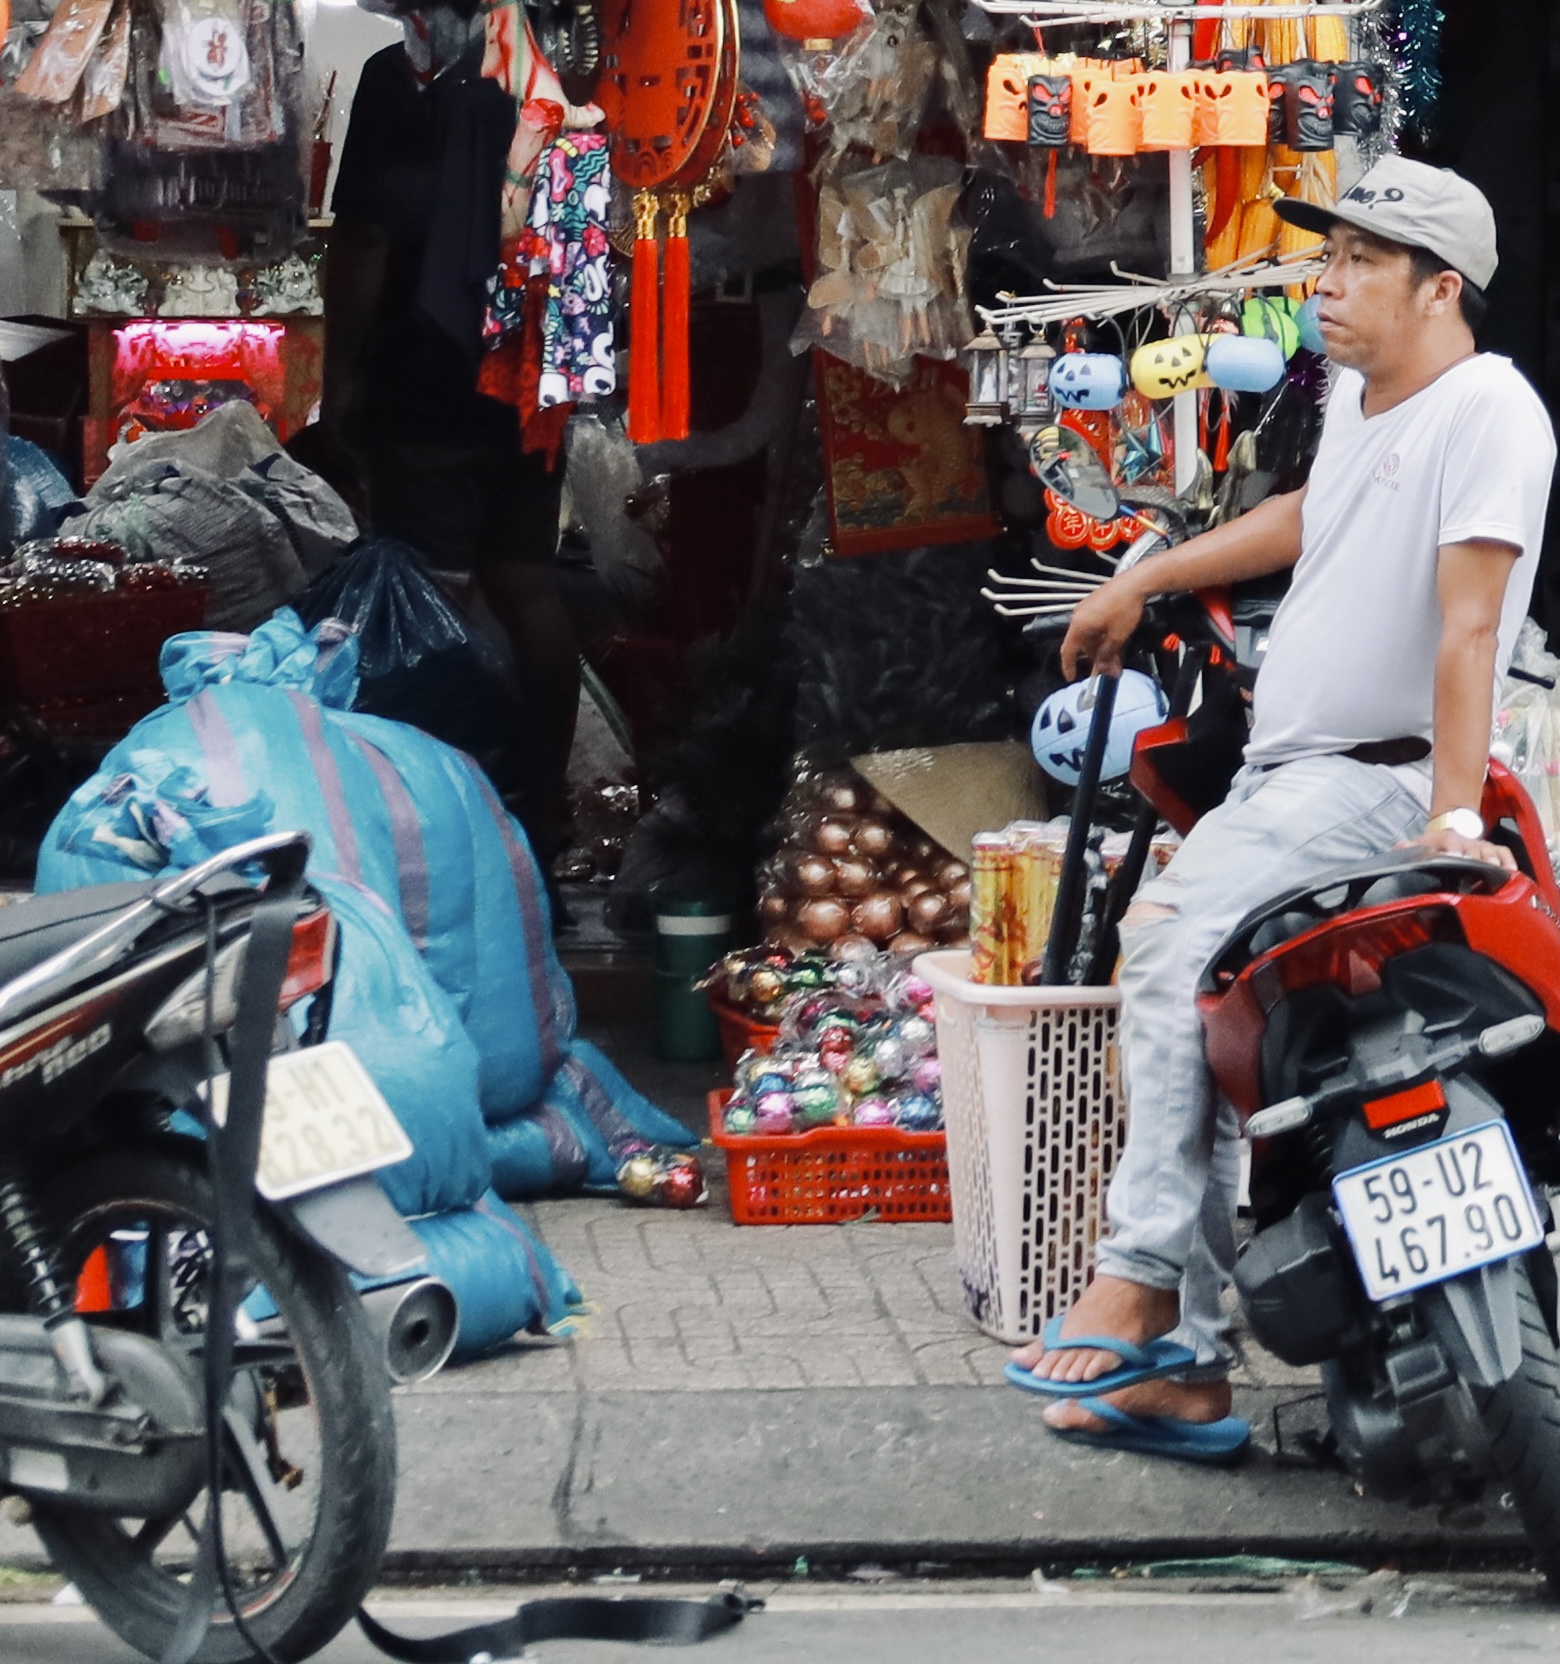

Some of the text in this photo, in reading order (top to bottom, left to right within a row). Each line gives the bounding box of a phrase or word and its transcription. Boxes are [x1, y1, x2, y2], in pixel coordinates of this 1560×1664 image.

[1382, 1111, 1441, 1140] HONDA
[1362, 1140, 1493, 1225] 59-U2
[1374, 1193, 1523, 1284] 467.90
